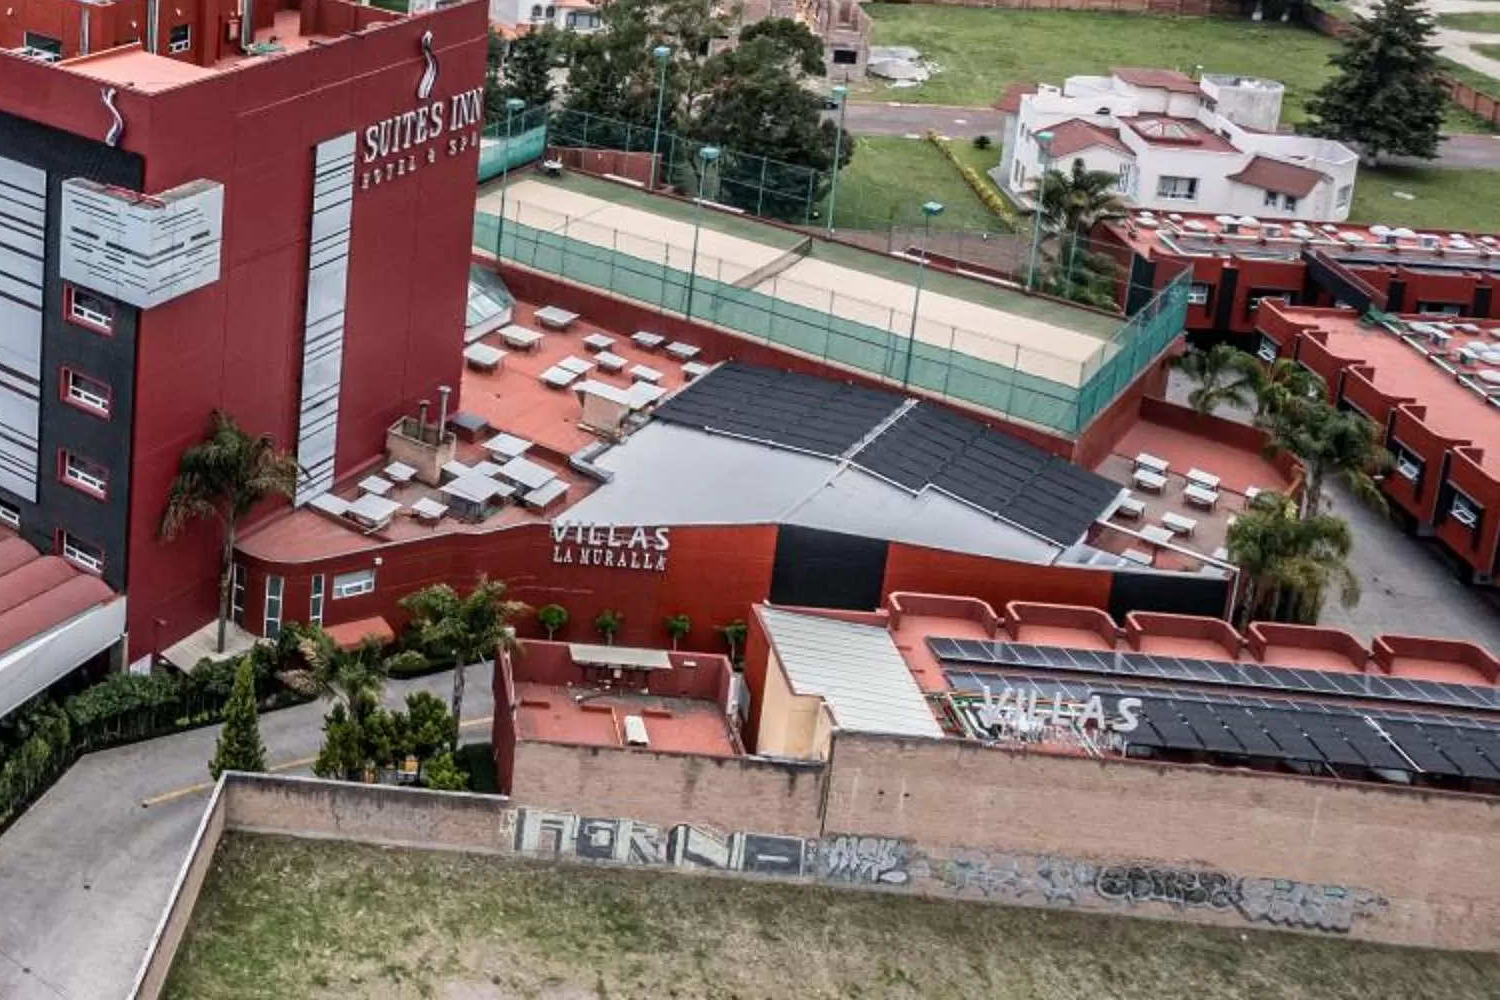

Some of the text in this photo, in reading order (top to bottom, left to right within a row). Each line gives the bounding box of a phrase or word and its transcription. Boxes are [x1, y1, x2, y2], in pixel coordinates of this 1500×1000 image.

[363, 87, 484, 163] SUITES INN
[361, 154, 417, 190] HOTEL
[551, 519, 670, 551] VILLAS
[553, 545, 667, 571] LA MURALLA
[979, 685, 1143, 733] VILLAS
